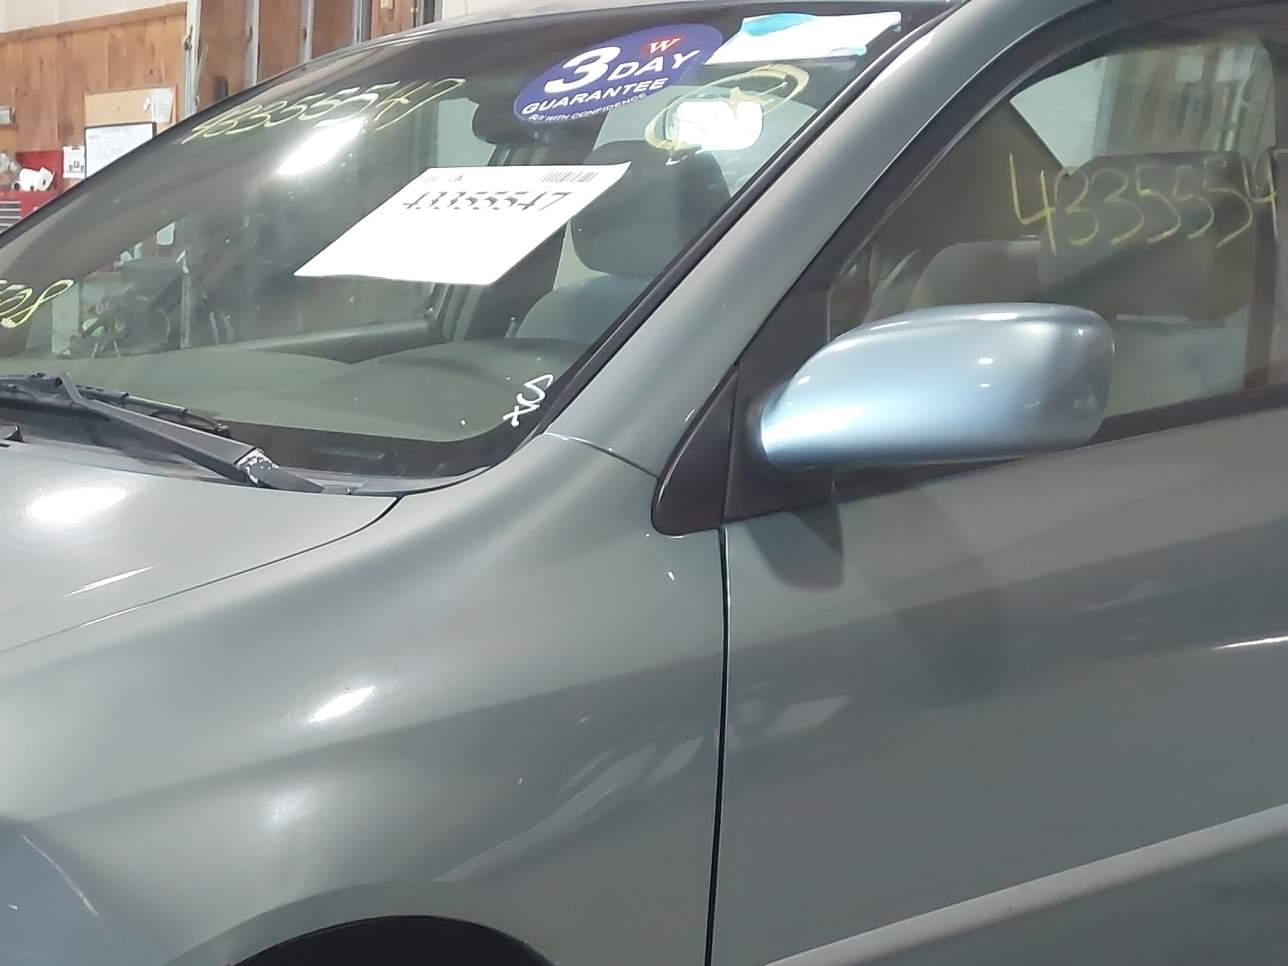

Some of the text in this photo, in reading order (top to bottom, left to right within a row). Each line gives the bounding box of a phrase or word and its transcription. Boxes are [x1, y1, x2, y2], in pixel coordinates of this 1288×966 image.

[543, 46, 701, 94] 3 DAY
[521, 77, 669, 115] GUARANTEE
[401, 191, 573, 211] 43355547
